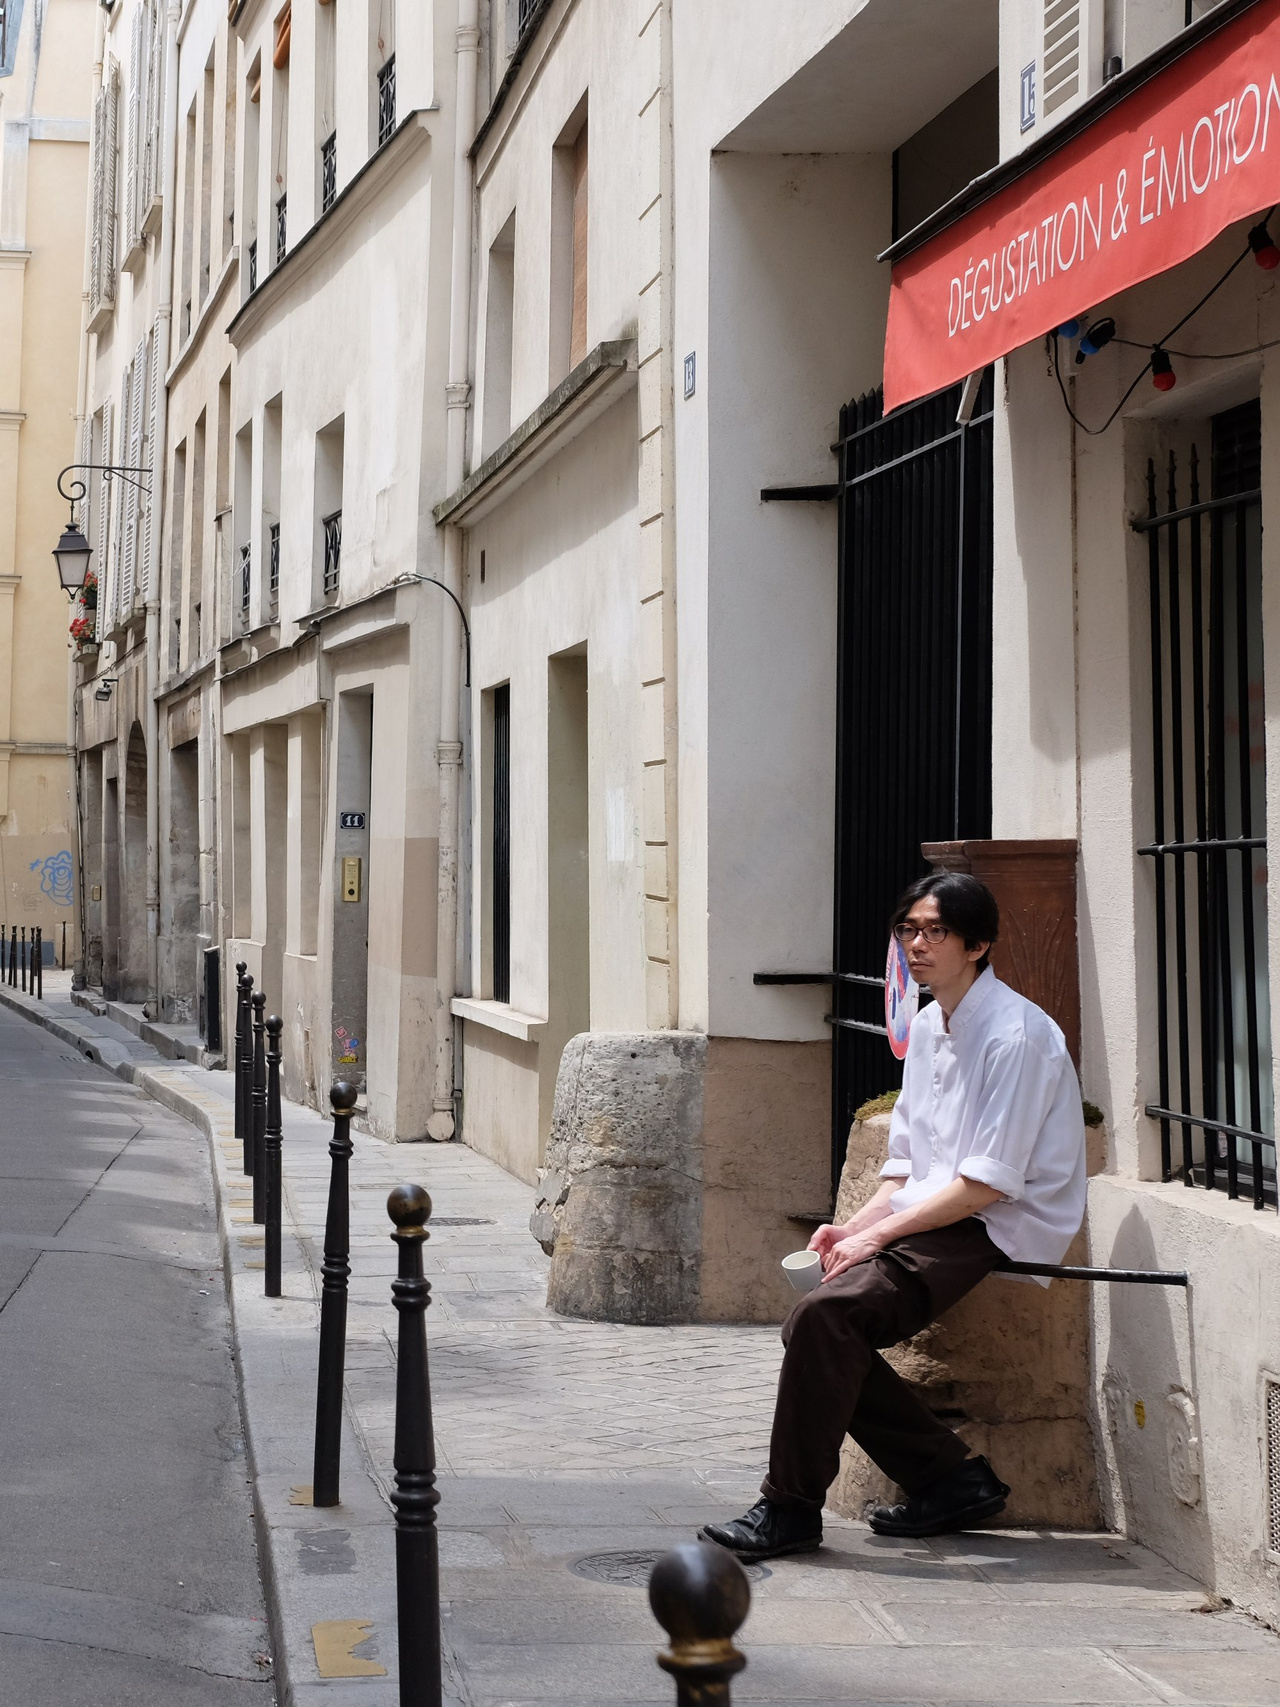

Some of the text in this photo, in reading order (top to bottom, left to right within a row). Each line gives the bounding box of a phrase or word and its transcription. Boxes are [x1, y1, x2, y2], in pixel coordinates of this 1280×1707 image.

[947, 183, 1103, 338] DÉGUSTATION
[1110, 168, 1130, 241] &
[685, 360, 693, 392] 13
[345, 815, 360, 827] 11
